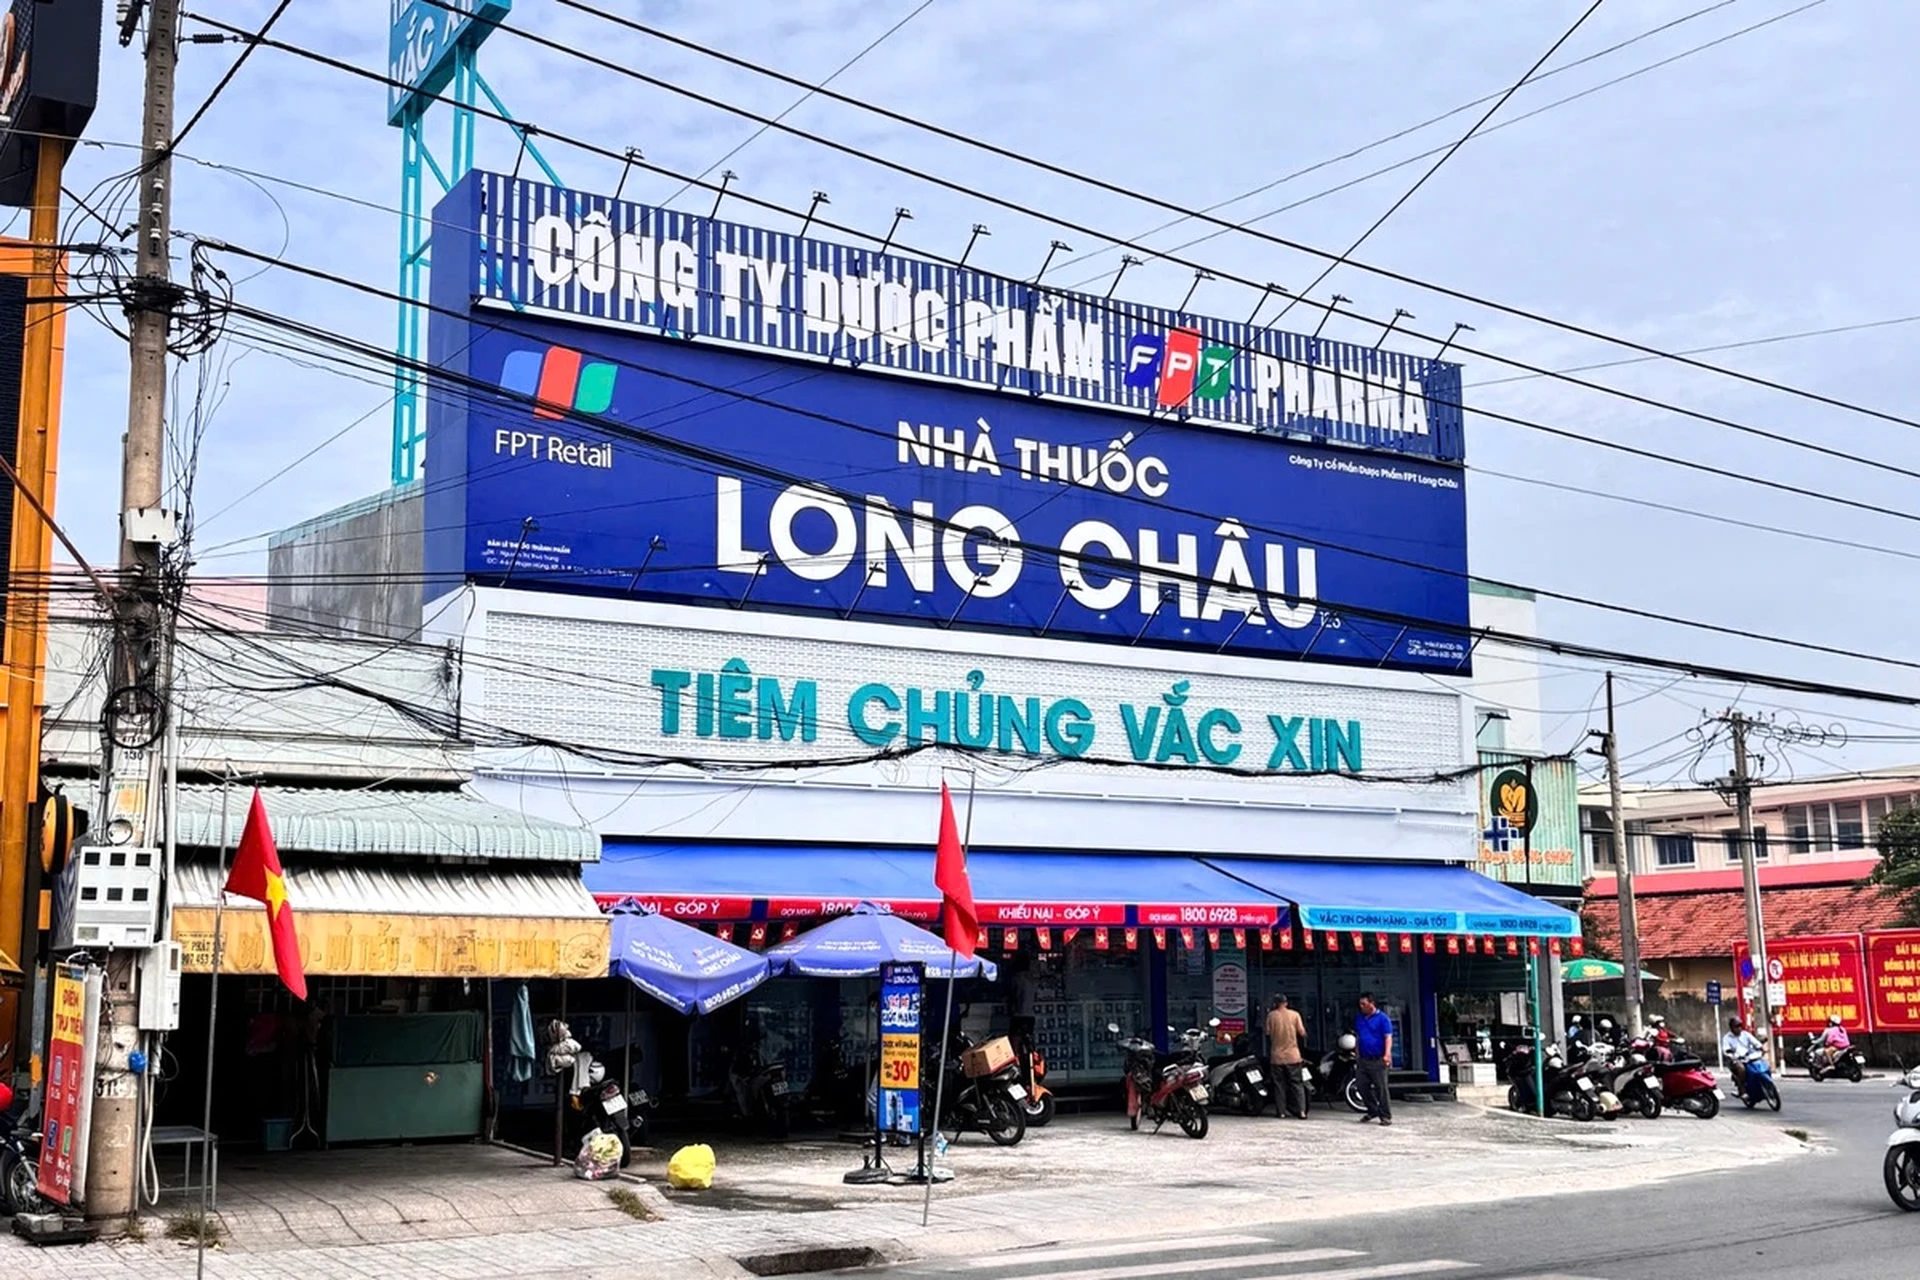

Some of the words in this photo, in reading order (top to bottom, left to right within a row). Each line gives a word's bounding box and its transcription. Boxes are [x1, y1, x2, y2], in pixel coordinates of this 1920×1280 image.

[533, 211, 697, 309] CÔNG
[715, 251, 787, 329] TY
[806, 269, 948, 353] DƯỢC
[964, 295, 1101, 386] PHẨM
[1127, 336, 1232, 397] FPT
[1256, 354, 1430, 436] PHARMA
[495, 429, 543, 461] FPT
[547, 433, 613, 470] Retail
[897, 417, 1001, 477] NHÀ
[1014, 431, 1170, 498] THUỐC
[1313, 458, 1323, 470] Ty
[1418, 474, 1438, 488] Long
[717, 475, 1023, 598] LONG
[1058, 517, 1318, 630] CHÂU
[652, 657, 817, 742] TIÊM
[848, 669, 1096, 757] CHỦNG
[1120, 681, 1242, 764] VẮC
[1267, 714, 1362, 772] XIN
[673, 900, 708, 915] GÓP
[710, 899, 721, 914] Ý
[998, 903, 1032, 920] KHIẾU
[1033, 907, 1054, 923] NẠI
[1064, 905, 1091, 920] GÓP
[1092, 904, 1101, 921] Ý
[1180, 907, 1206, 922] 1800
[1209, 907, 1237, 922] 6928
